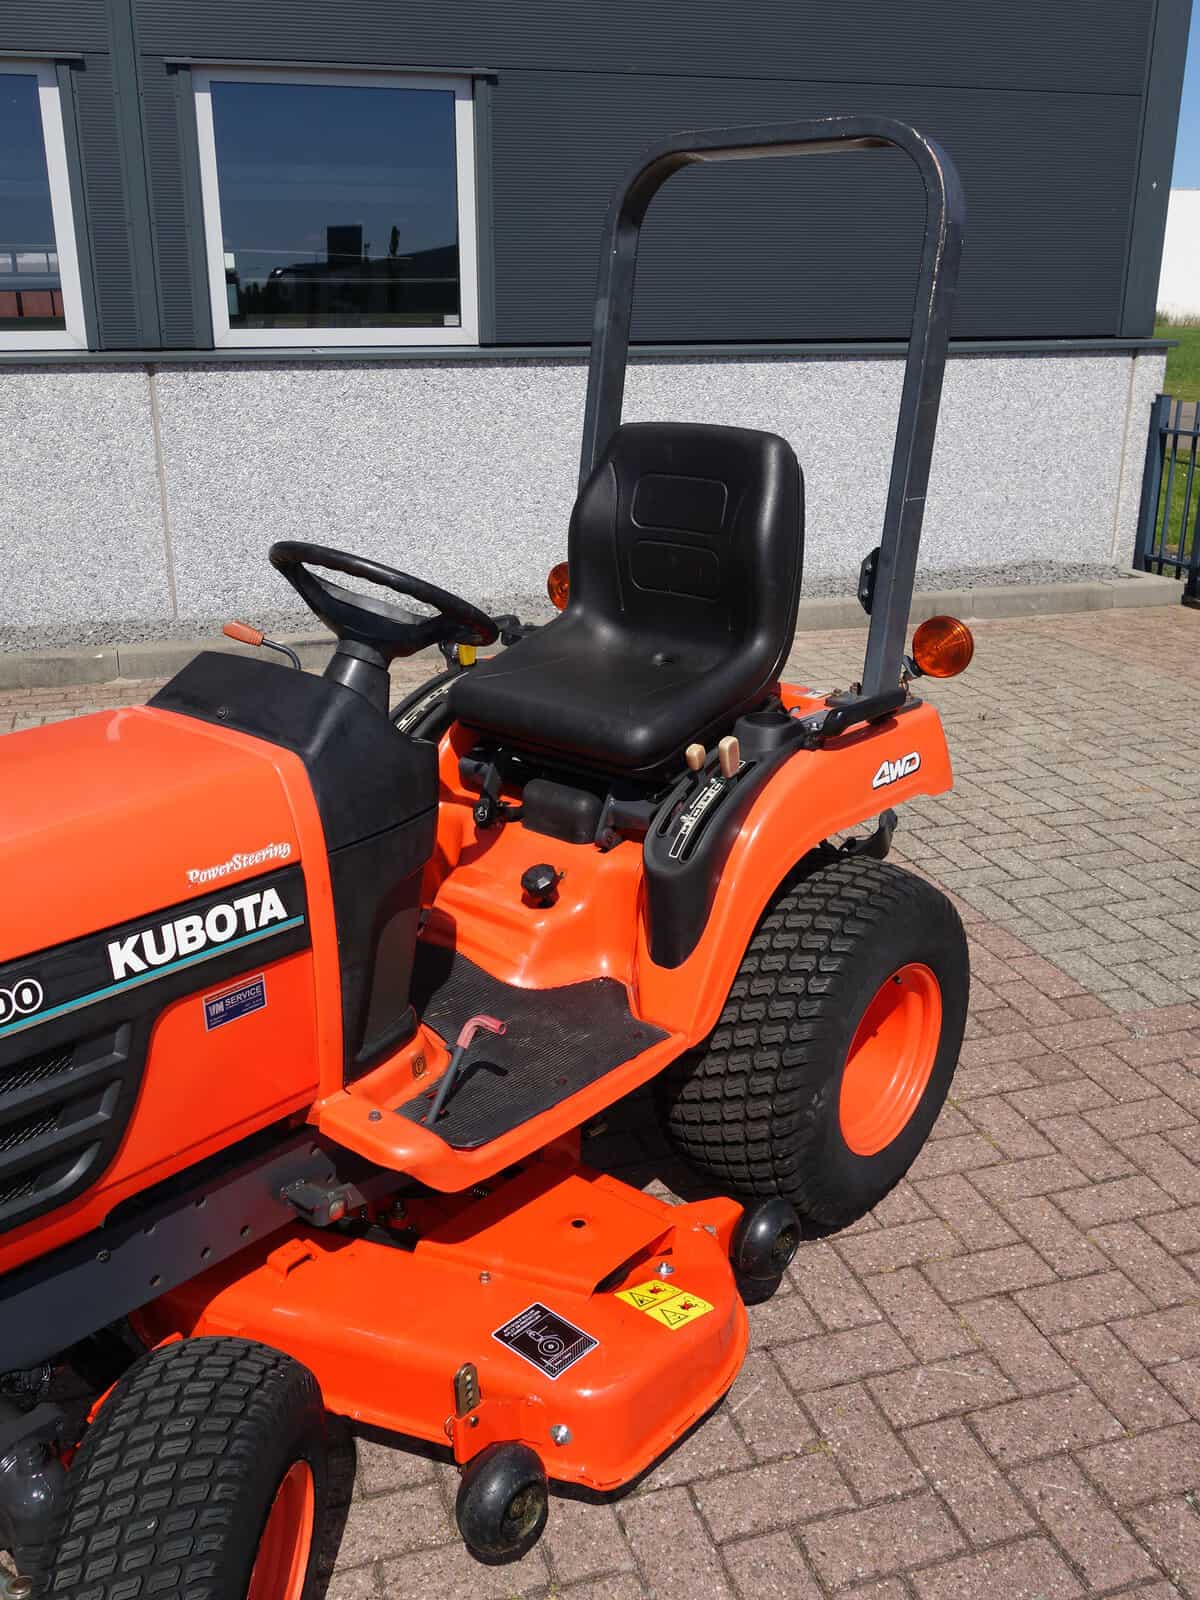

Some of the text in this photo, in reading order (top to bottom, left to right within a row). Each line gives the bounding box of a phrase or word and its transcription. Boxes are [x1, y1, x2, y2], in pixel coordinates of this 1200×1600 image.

[872, 752, 921, 790] 4WD
[107, 888, 288, 980] KUBOTA
[224, 984, 262, 1007] SERVICE
